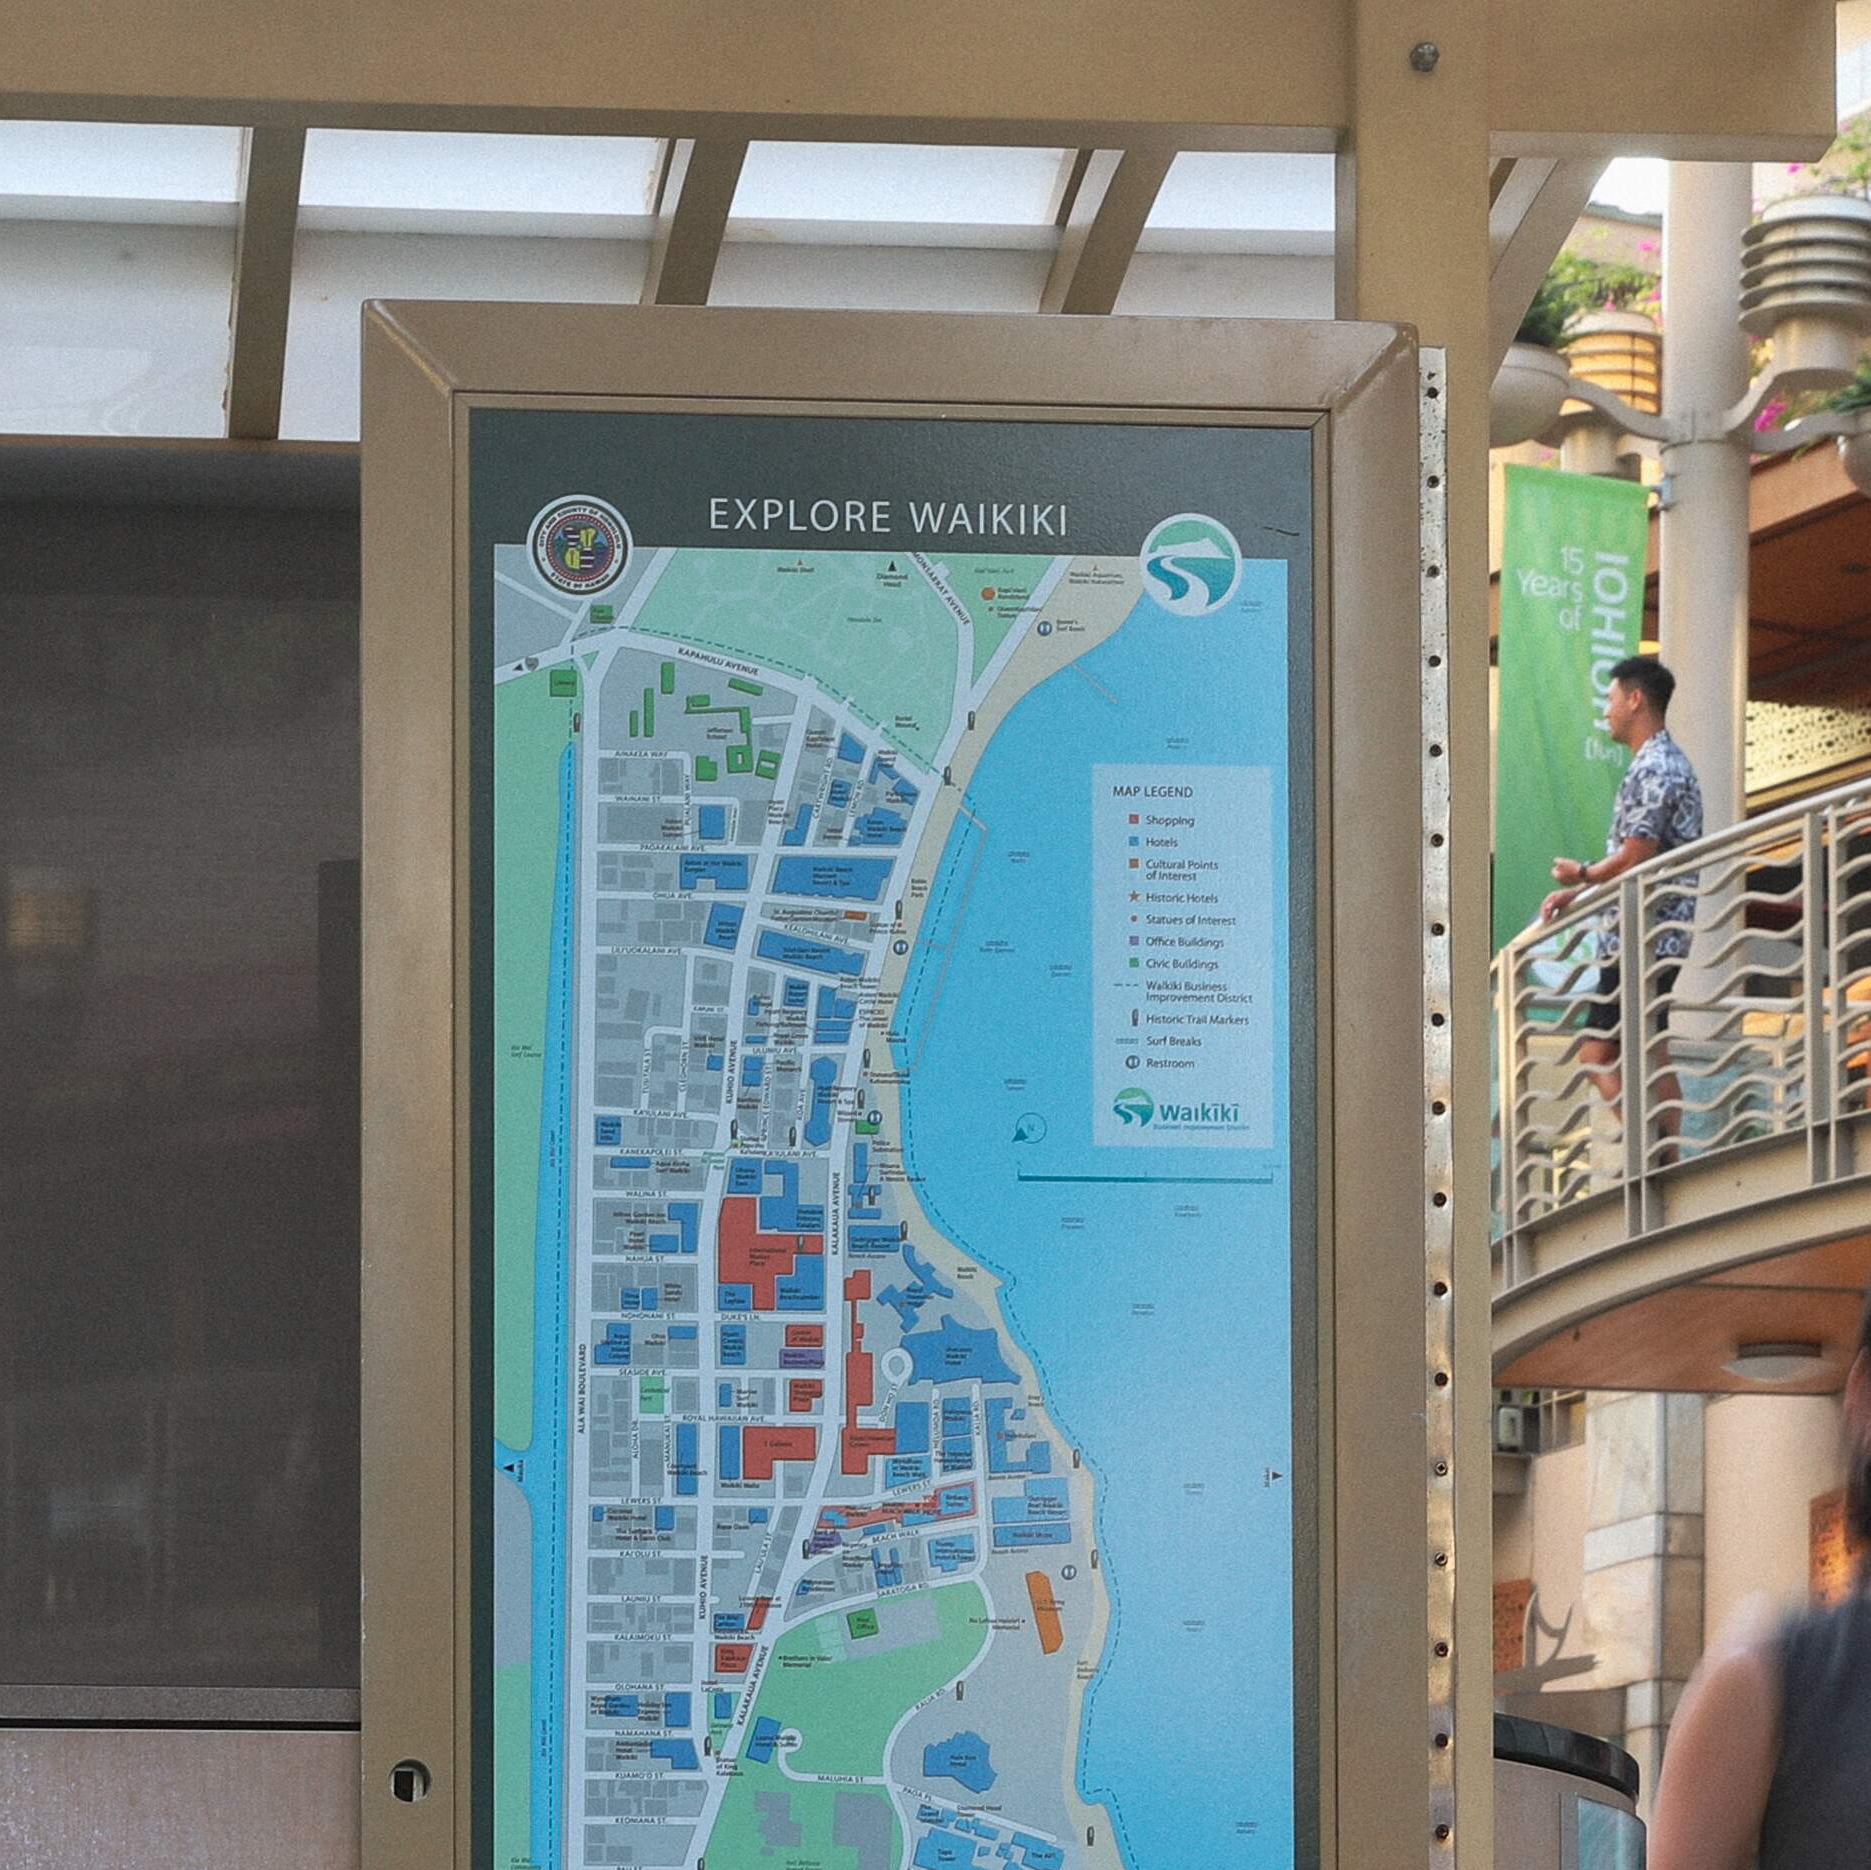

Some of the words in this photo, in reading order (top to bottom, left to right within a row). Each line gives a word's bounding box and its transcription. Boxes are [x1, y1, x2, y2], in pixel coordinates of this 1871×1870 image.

[710, 497, 891, 534] EXPLORE
[909, 501, 1068, 537] WAIKIKI
[1561, 546, 1585, 575] 15
[913, 552, 948, 595] MONSARRAT
[946, 597, 970, 625] AVENUE
[1517, 568, 1584, 603] Years
[1558, 604, 1581, 631] of
[679, 648, 724, 666] KAPAHULU
[725, 659, 758, 676] AVENUE
[651, 750, 668, 758] WAY
[1113, 786, 1140, 798] MAP
[1144, 786, 1193, 798] LEGEND
[1145, 814, 1195, 828] Shopping
[1145, 837, 1178, 848] Hotels
[1145, 859, 1185, 870] Cultural
[1188, 860, 1218, 870] Points
[1145, 870, 1157, 881] of
[1159, 871, 1197, 881] Interest
[1145, 892, 1185, 903] Historic
[1187, 893, 1218, 903] Hotels
[1145, 914, 1183, 925] Statues
[1185, 914, 1197, 925] of
[1198, 915, 1236, 925] Interest
[1145, 936, 1176, 947] Office
[1178, 936, 1224, 948] Buildings
[1145, 958, 1170, 969] Civic
[1172, 958, 1218, 971] Buildings
[1145, 980, 1182, 991] Waikiki
[1184, 981, 1227, 992] Business
[1145, 992, 1215, 1005] Improvement
[1217, 992, 1253, 1004] District
[1145, 1014, 1185, 1025] Historic
[1187, 1014, 1206, 1025] Trail
[1209, 1014, 1249, 1026] Markers
[1145, 1035, 1167, 1046] Surf
[1169, 1036, 1202, 1047] Breaks
[728, 1040, 738, 1072] AVENUE
[1146, 1057, 1195, 1069] Restroom
[832, 1172, 840, 1207] AVENUE
[578, 1344, 587, 1395] BOULEVARD
[578, 1397, 587, 1416] WAI
[578, 1419, 587, 1434] ALA
[872, 1534, 897, 1543] BEACH
[898, 1530, 919, 1539] WALK
[700, 1555, 708, 1588] AVENUE
[737, 1681, 757, 1726] KALAKAUA
[752, 1646, 768, 1679] AVENUE
